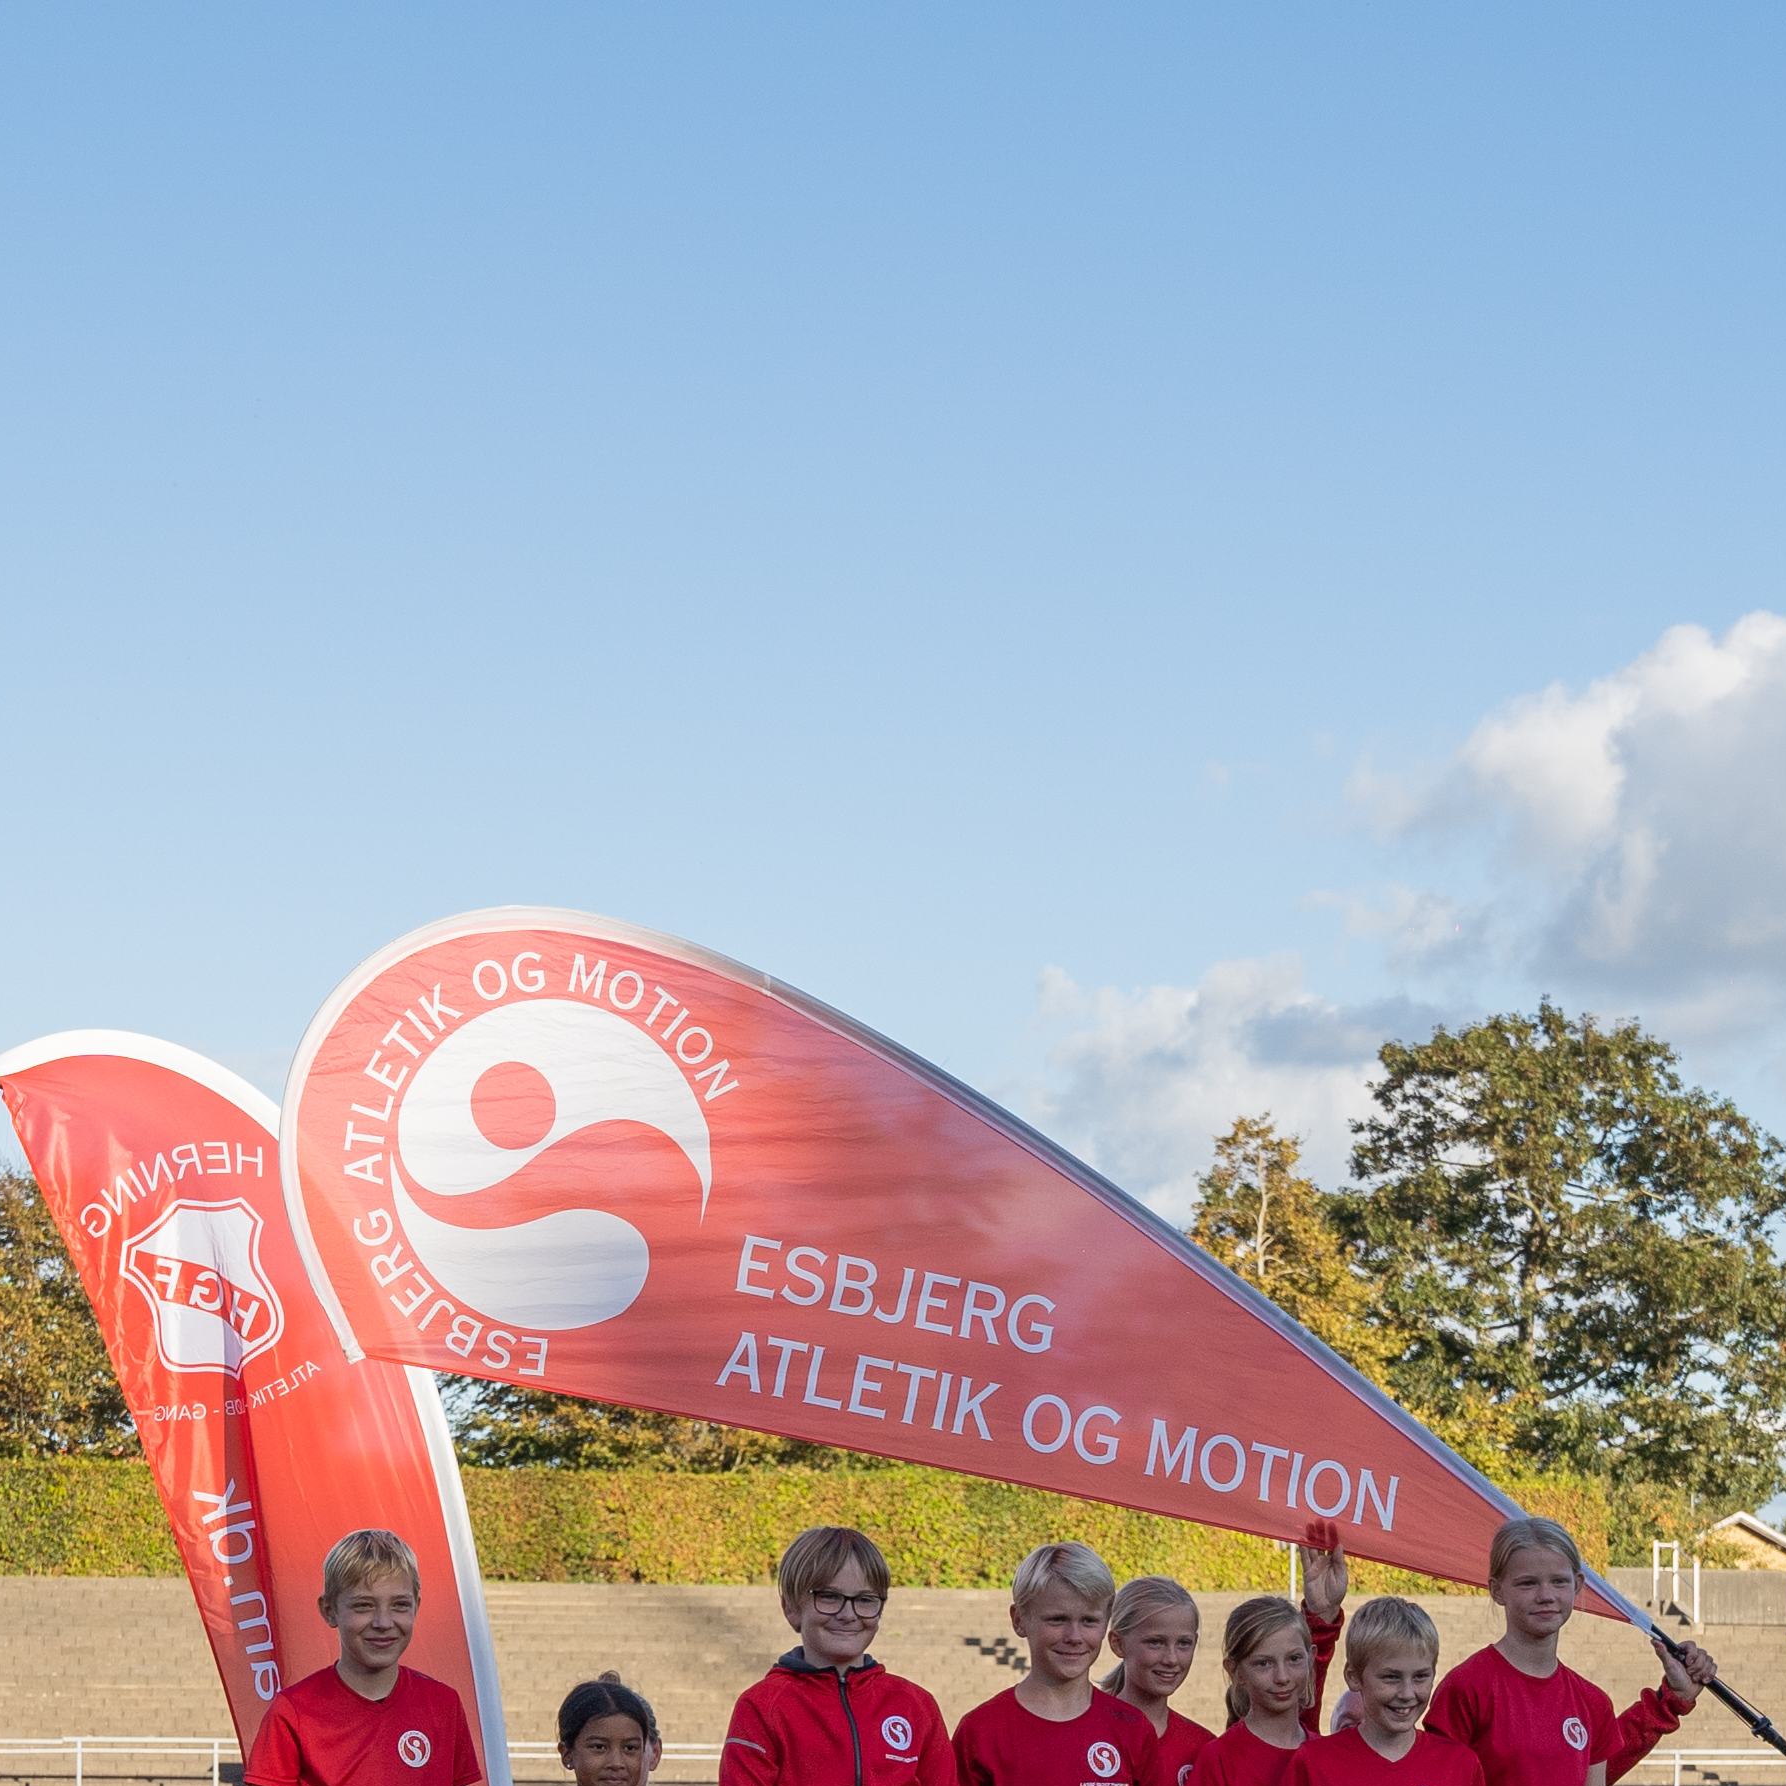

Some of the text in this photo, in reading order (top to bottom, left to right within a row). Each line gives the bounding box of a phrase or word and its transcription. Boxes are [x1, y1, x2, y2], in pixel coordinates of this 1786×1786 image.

[344, 951, 740, 1377] ESBJERG ATLETIK OG MOTION
[735, 1233, 1057, 1354] ESBJERG
[715, 1331, 1400, 1533] ATLETIK OG MOTION
